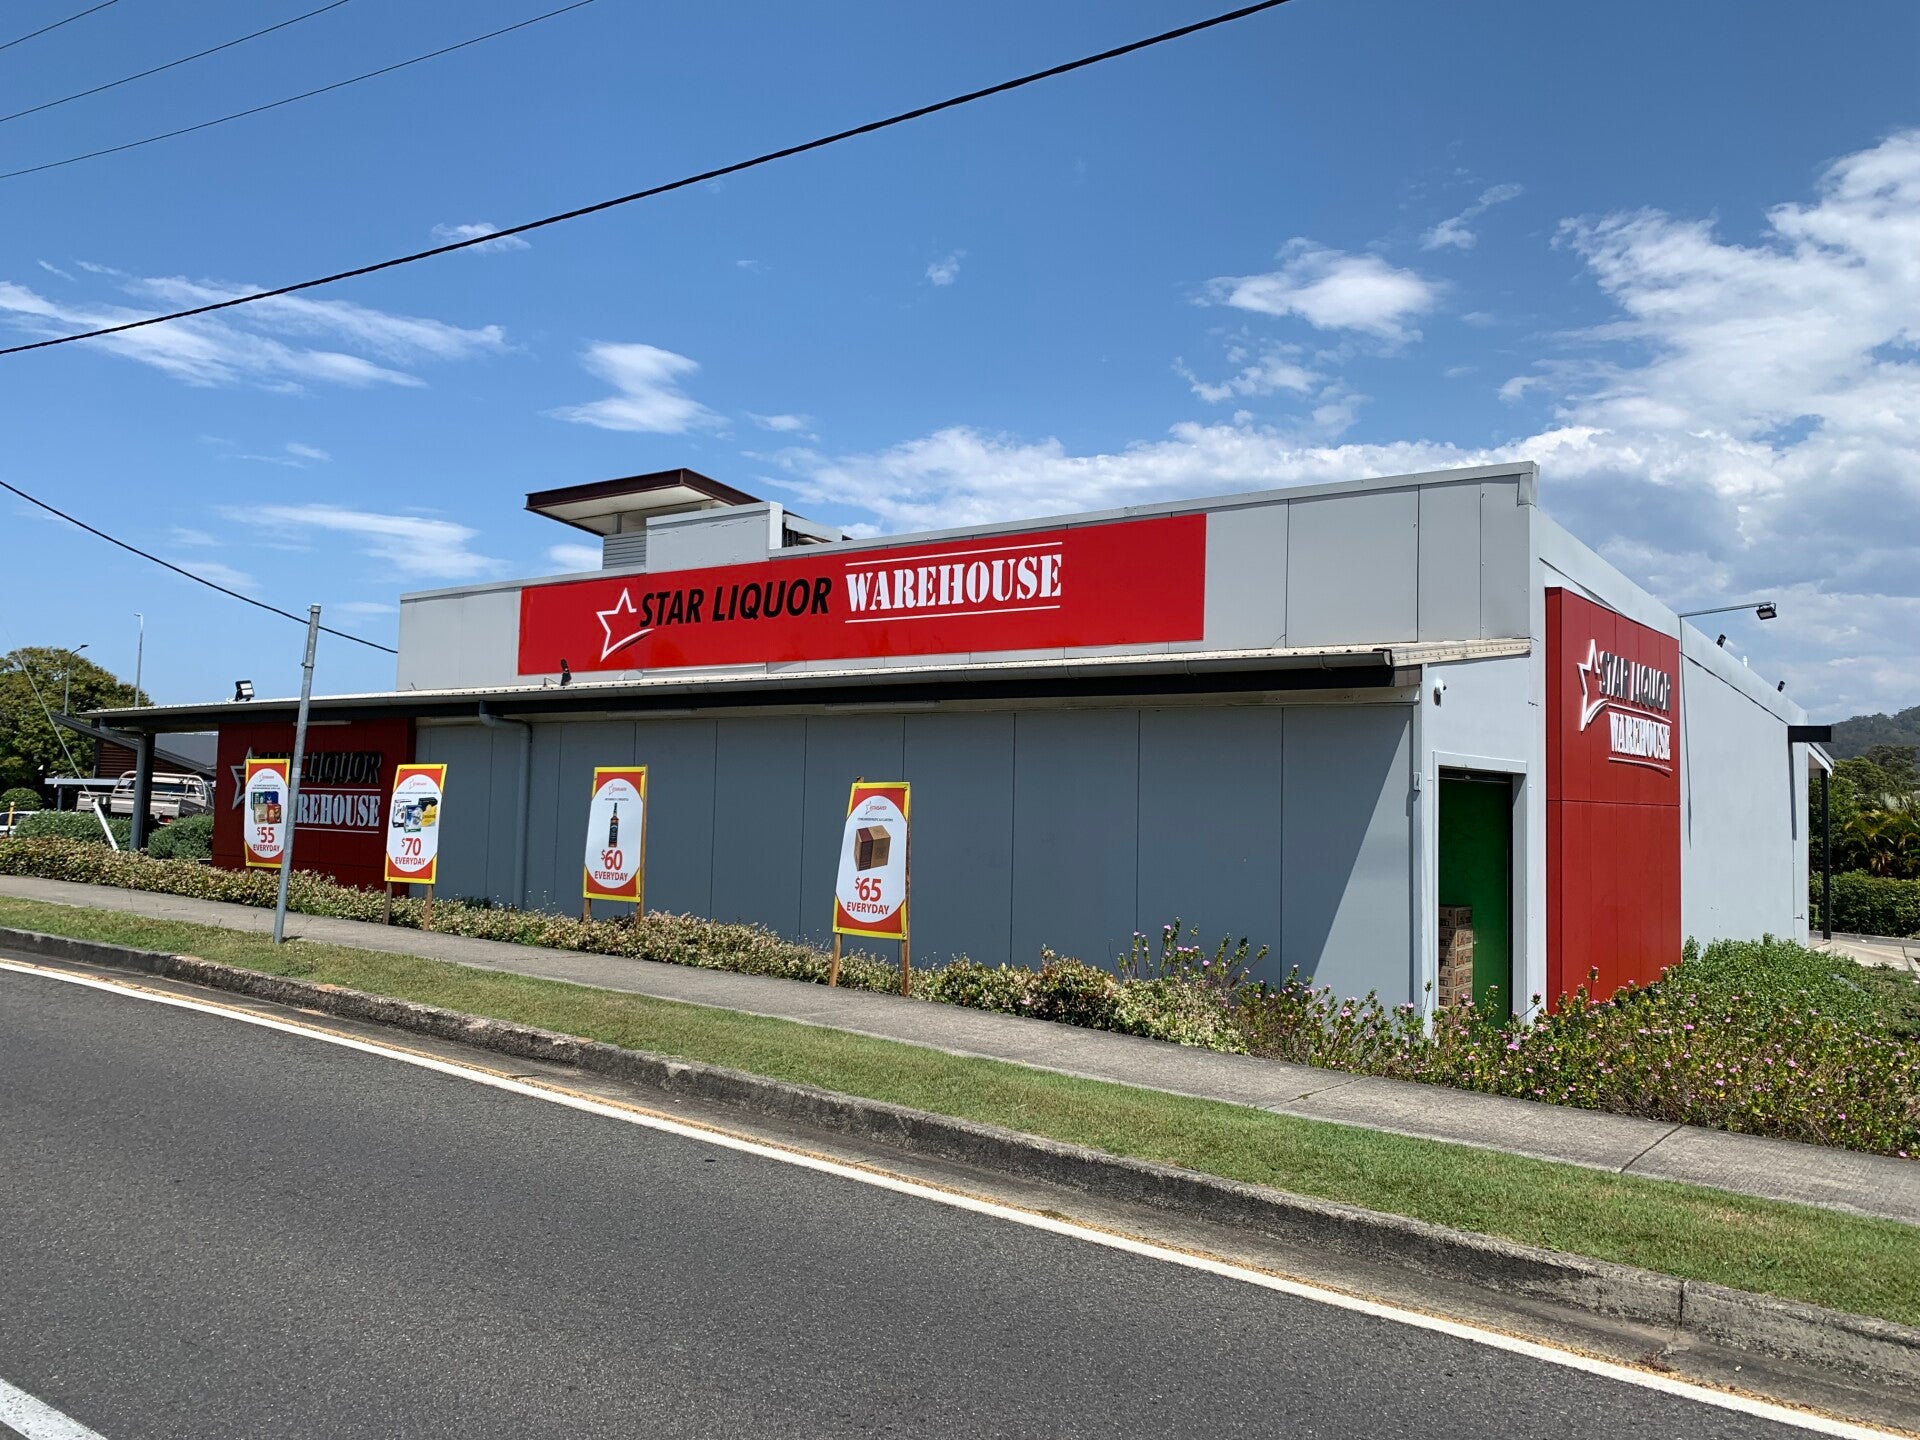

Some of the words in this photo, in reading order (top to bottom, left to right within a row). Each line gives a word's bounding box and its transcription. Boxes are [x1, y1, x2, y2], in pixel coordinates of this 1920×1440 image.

[639, 587, 704, 628] STAR
[711, 576, 833, 622] LIQUOR
[845, 554, 1062, 613] WAREHOUSE
[1599, 651, 1630, 701] STAR
[1630, 661, 1672, 712] LIQUOR
[1608, 712, 1671, 761] WAREHOUSE
[305, 751, 382, 784] LIQUOR
[295, 793, 381, 827] REHOUSE
[256, 826, 275, 844] $55
[253, 843, 281, 852] EVERYDAY
[401, 837, 422, 856] $70
[394, 856, 426, 866] EVERYDAY
[601, 849, 623, 871] $60
[594, 870, 629, 882] EVERYDAY
[854, 876, 882, 902] $65
[846, 901, 890, 915] EVERYDAY
